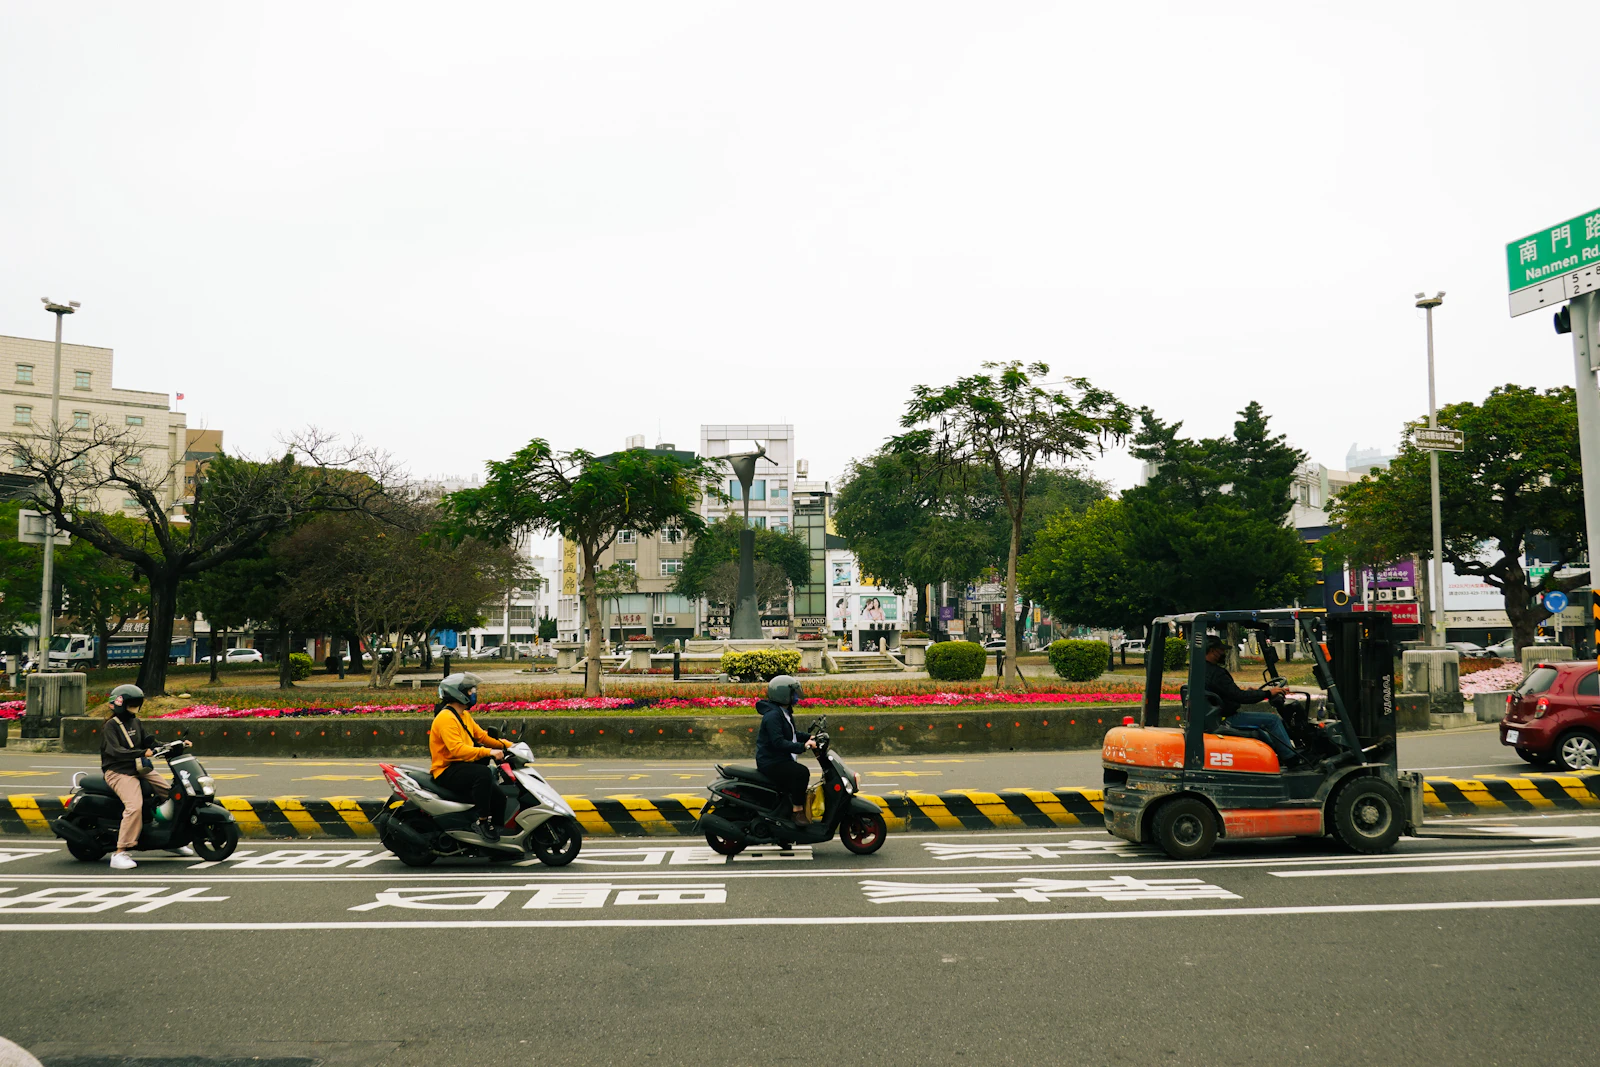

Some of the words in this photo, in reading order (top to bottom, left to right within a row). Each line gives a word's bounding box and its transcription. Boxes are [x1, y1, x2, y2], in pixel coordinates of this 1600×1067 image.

[1518, 213, 1600, 265] 南門路
[1525, 255, 1578, 281] Nanmen
[1382, 674, 1392, 716] TOYOTA
[1209, 752, 1234, 767] 25
